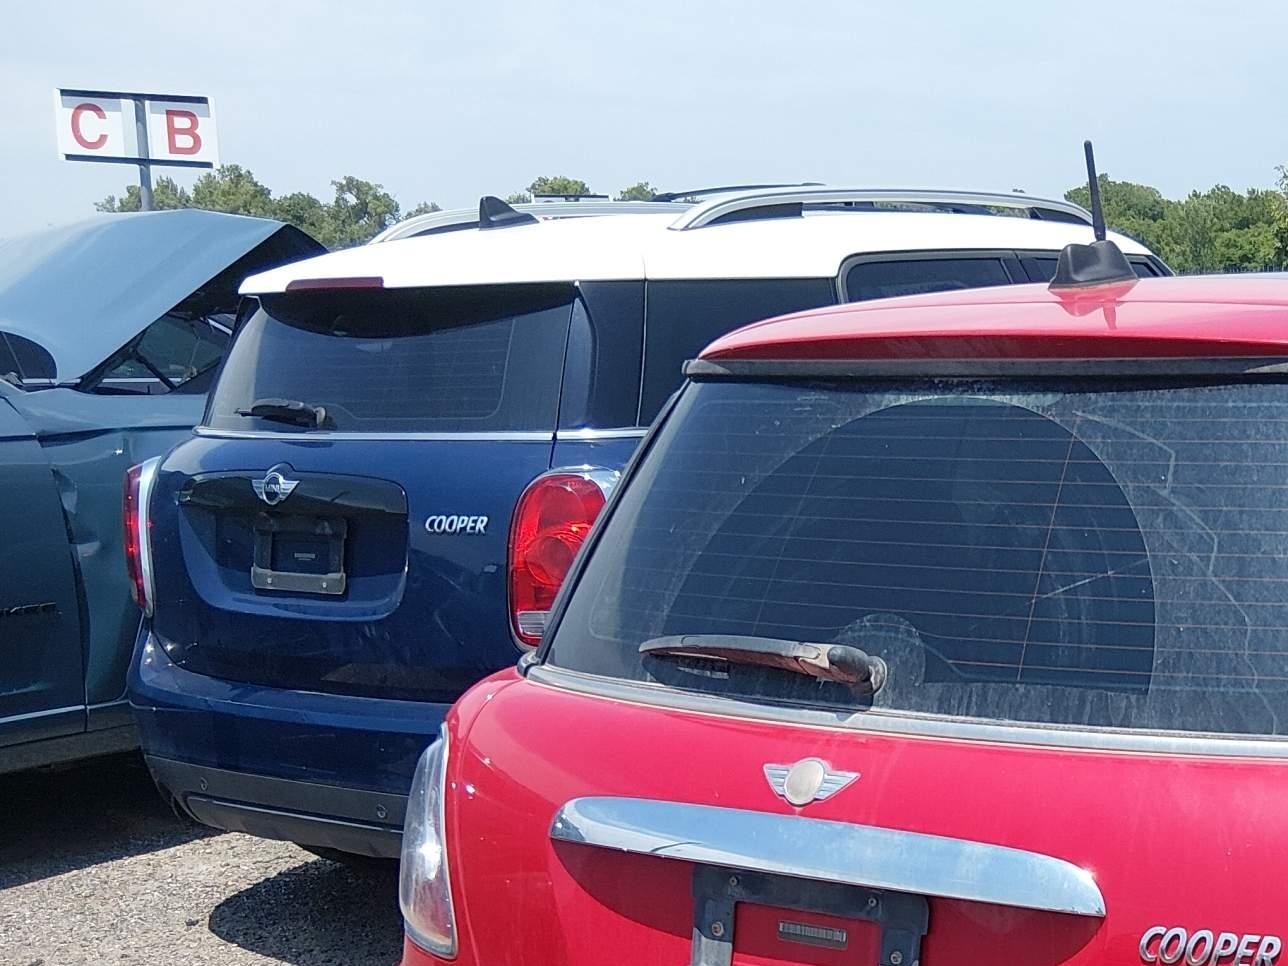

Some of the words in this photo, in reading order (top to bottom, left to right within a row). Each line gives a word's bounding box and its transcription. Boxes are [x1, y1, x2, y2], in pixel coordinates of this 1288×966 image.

[71, 102, 109, 150] C
[165, 109, 202, 155] B
[424, 515, 489, 534] COOPER
